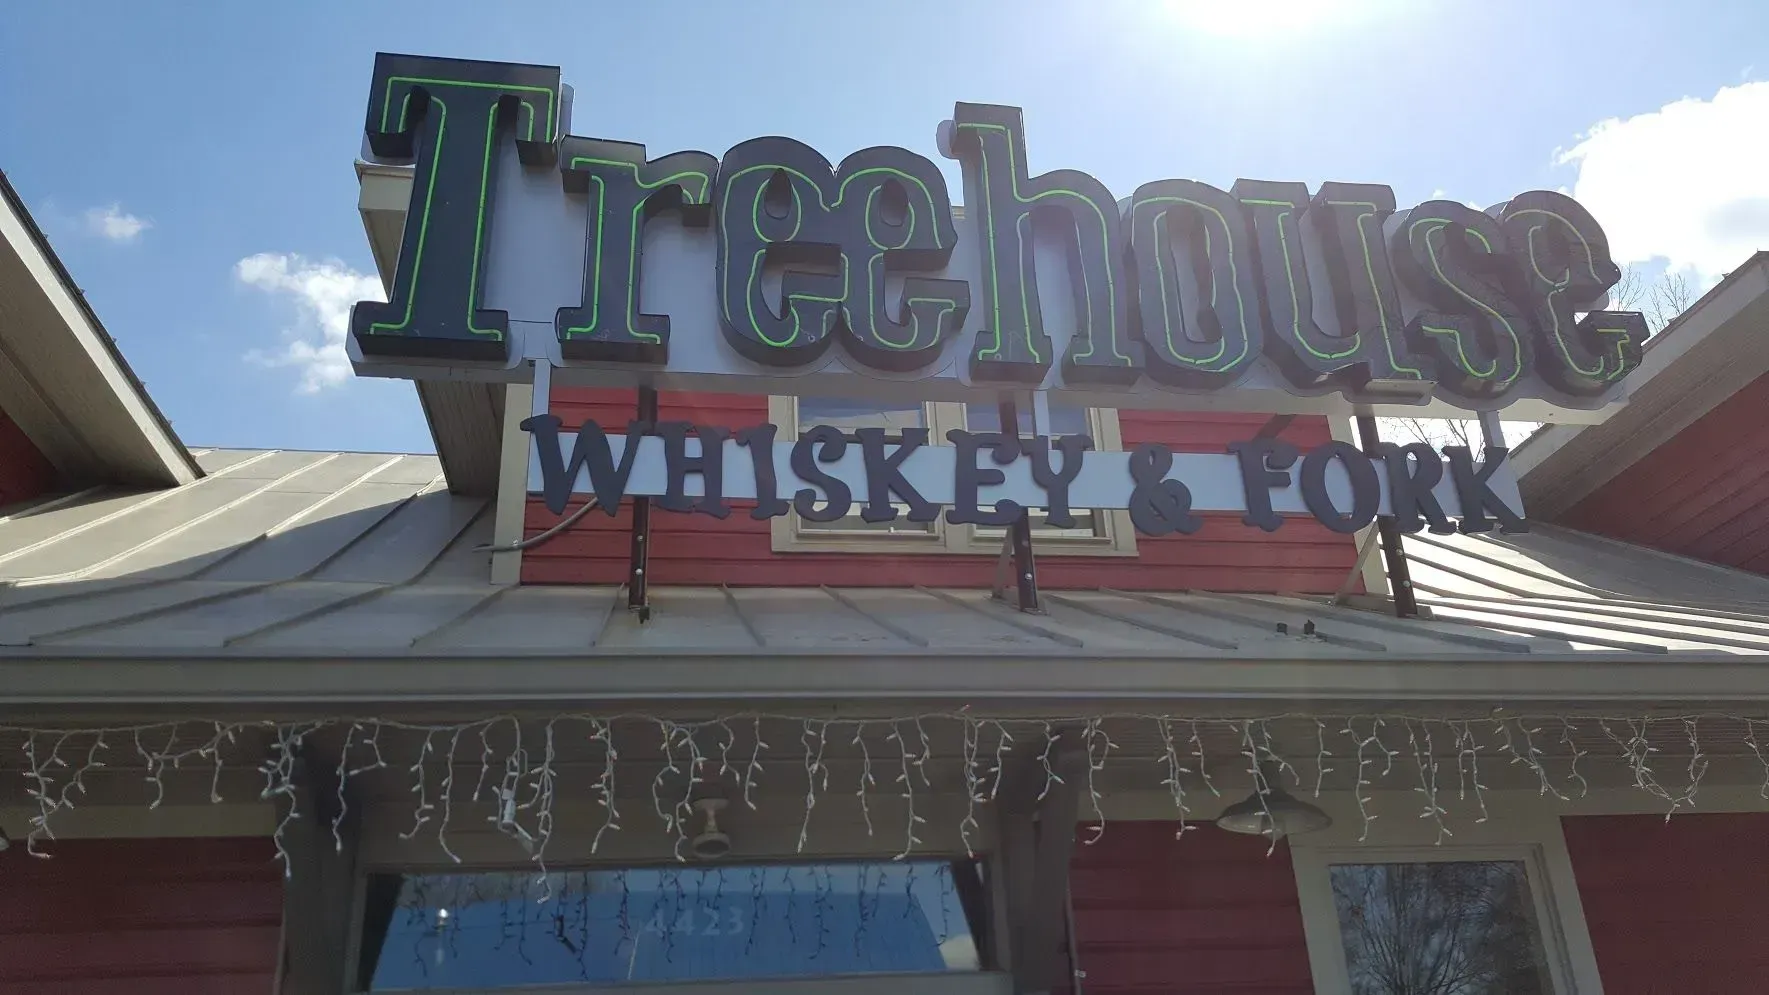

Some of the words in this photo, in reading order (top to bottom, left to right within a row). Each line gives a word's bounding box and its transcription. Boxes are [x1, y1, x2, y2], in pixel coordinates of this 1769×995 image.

[352, 52, 1650, 402] Treehouse
[520, 413, 1092, 529] WHISKEY
[1129, 442, 1204, 537] &
[1226, 437, 1529, 536] FORK
[645, 905, 746, 937] 4423
